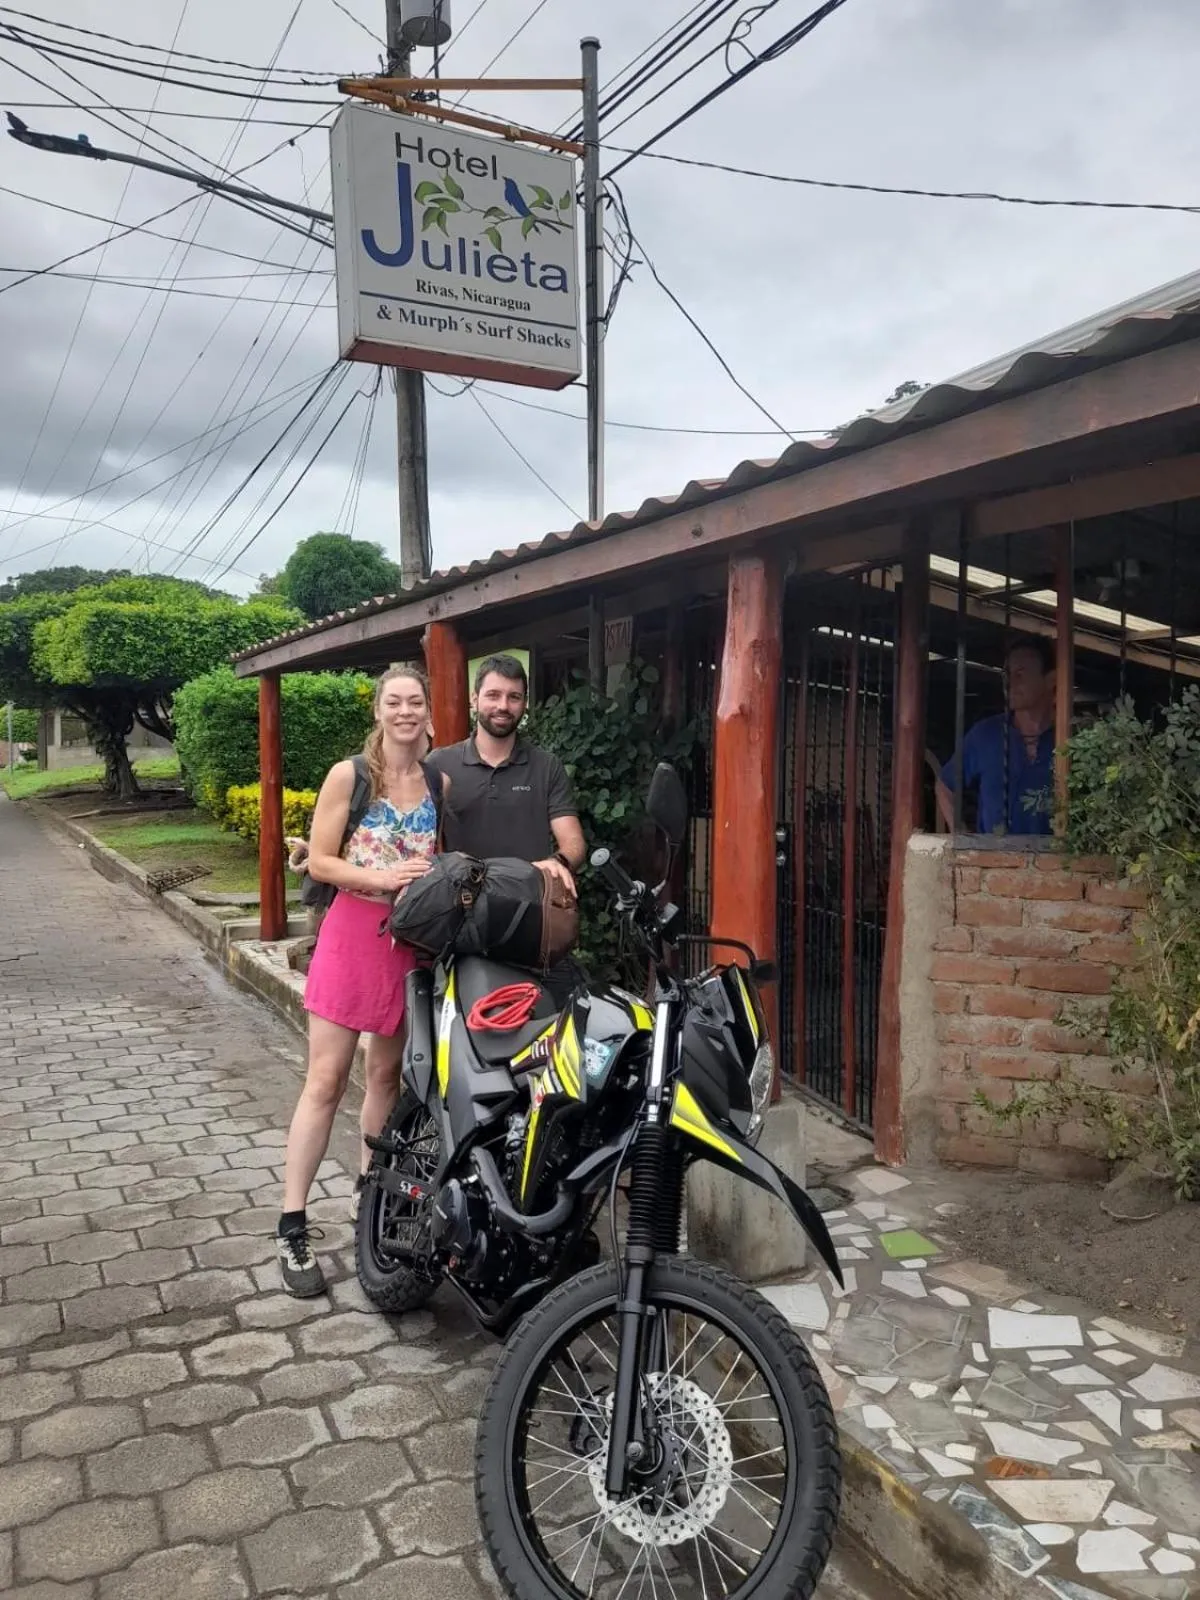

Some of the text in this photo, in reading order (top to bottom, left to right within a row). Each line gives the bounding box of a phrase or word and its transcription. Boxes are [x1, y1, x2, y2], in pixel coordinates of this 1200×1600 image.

[394, 132, 498, 180] Hotel
[361, 161, 569, 293] Julieta
[415, 279, 531, 312] Rivas, Nicaragua
[376, 304, 393, 321] &
[477, 320, 513, 340] Surf
[517, 328, 571, 349] Shacks
